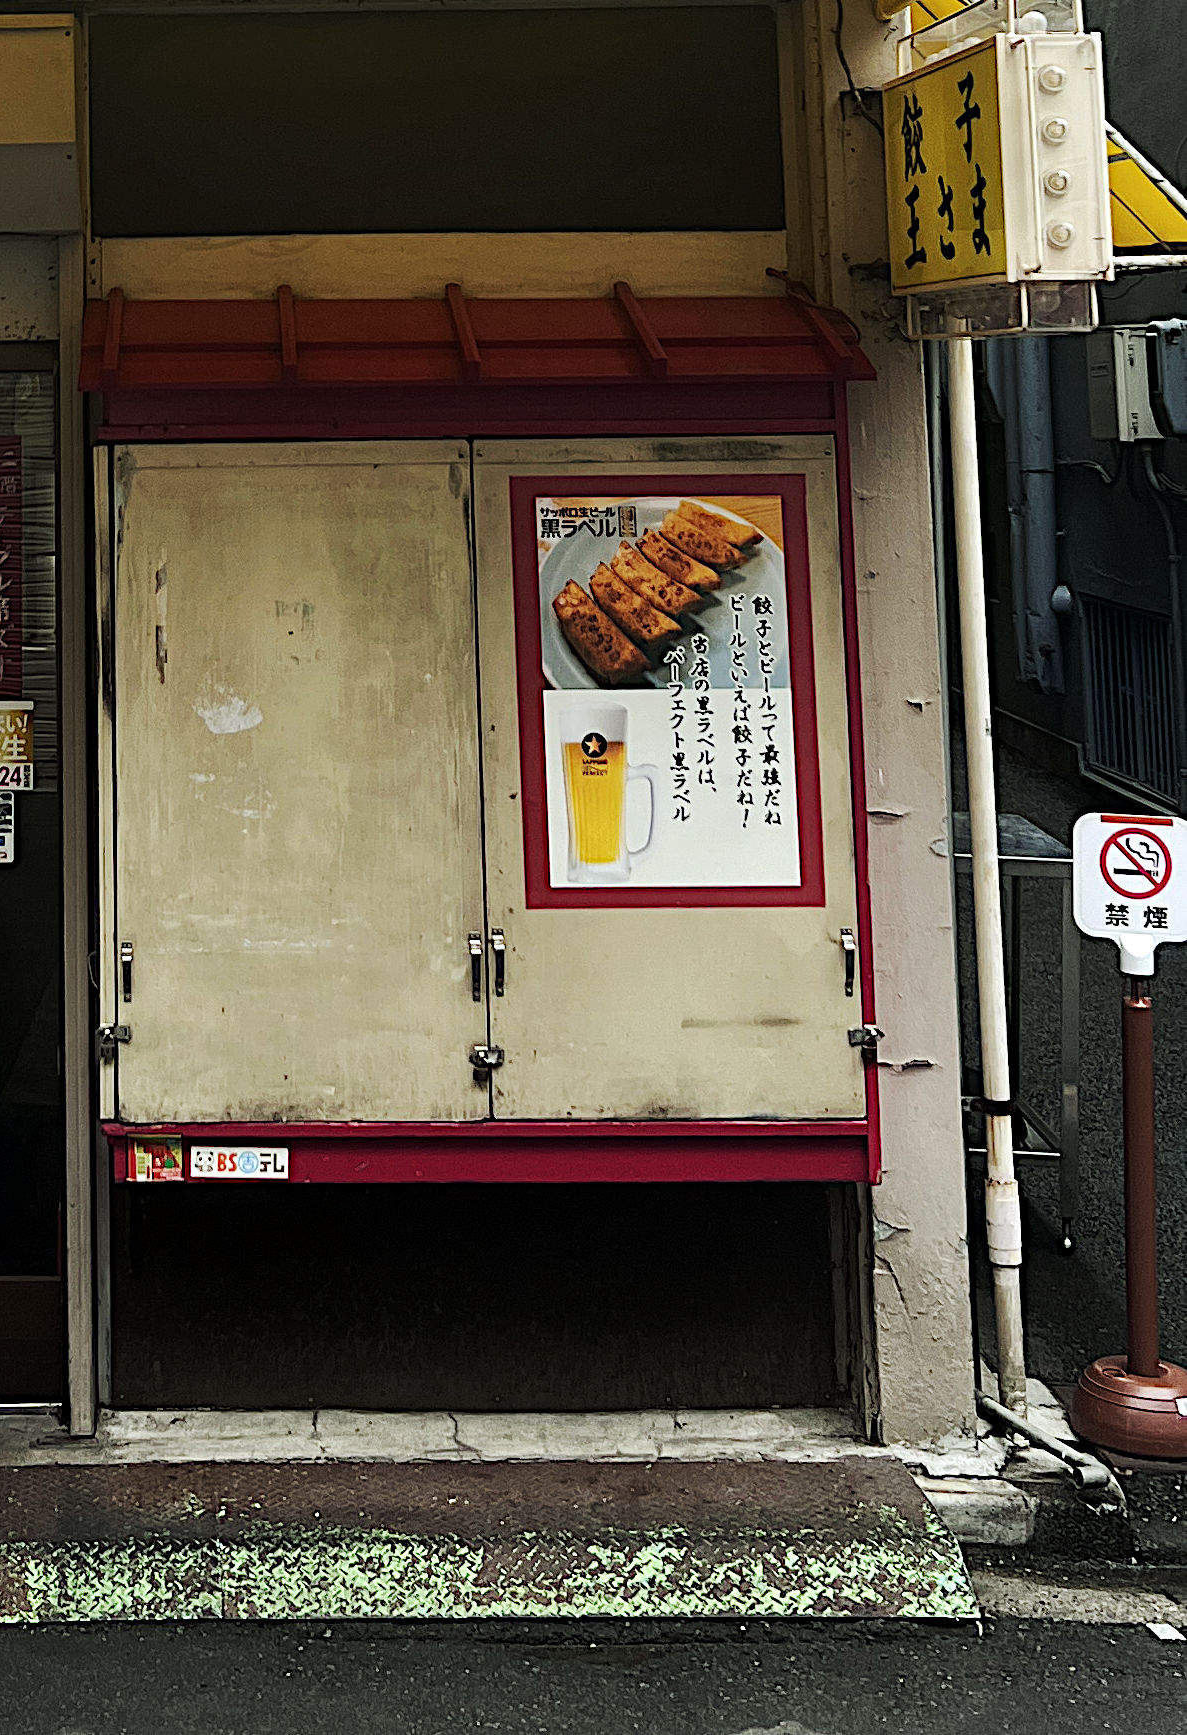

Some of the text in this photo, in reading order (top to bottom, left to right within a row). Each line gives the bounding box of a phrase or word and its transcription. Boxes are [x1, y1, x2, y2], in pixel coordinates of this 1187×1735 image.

[901, 70, 982, 182] 餃子
[540, 507, 615, 518] サッポロ生ビール
[541, 519, 616, 538] 黒ラベル
[665, 647, 691, 821] パーフェクト黒ラベル
[752, 595, 782, 825] 餃子とビールって最強だね
[1105, 902, 1169, 929] 禁煙
